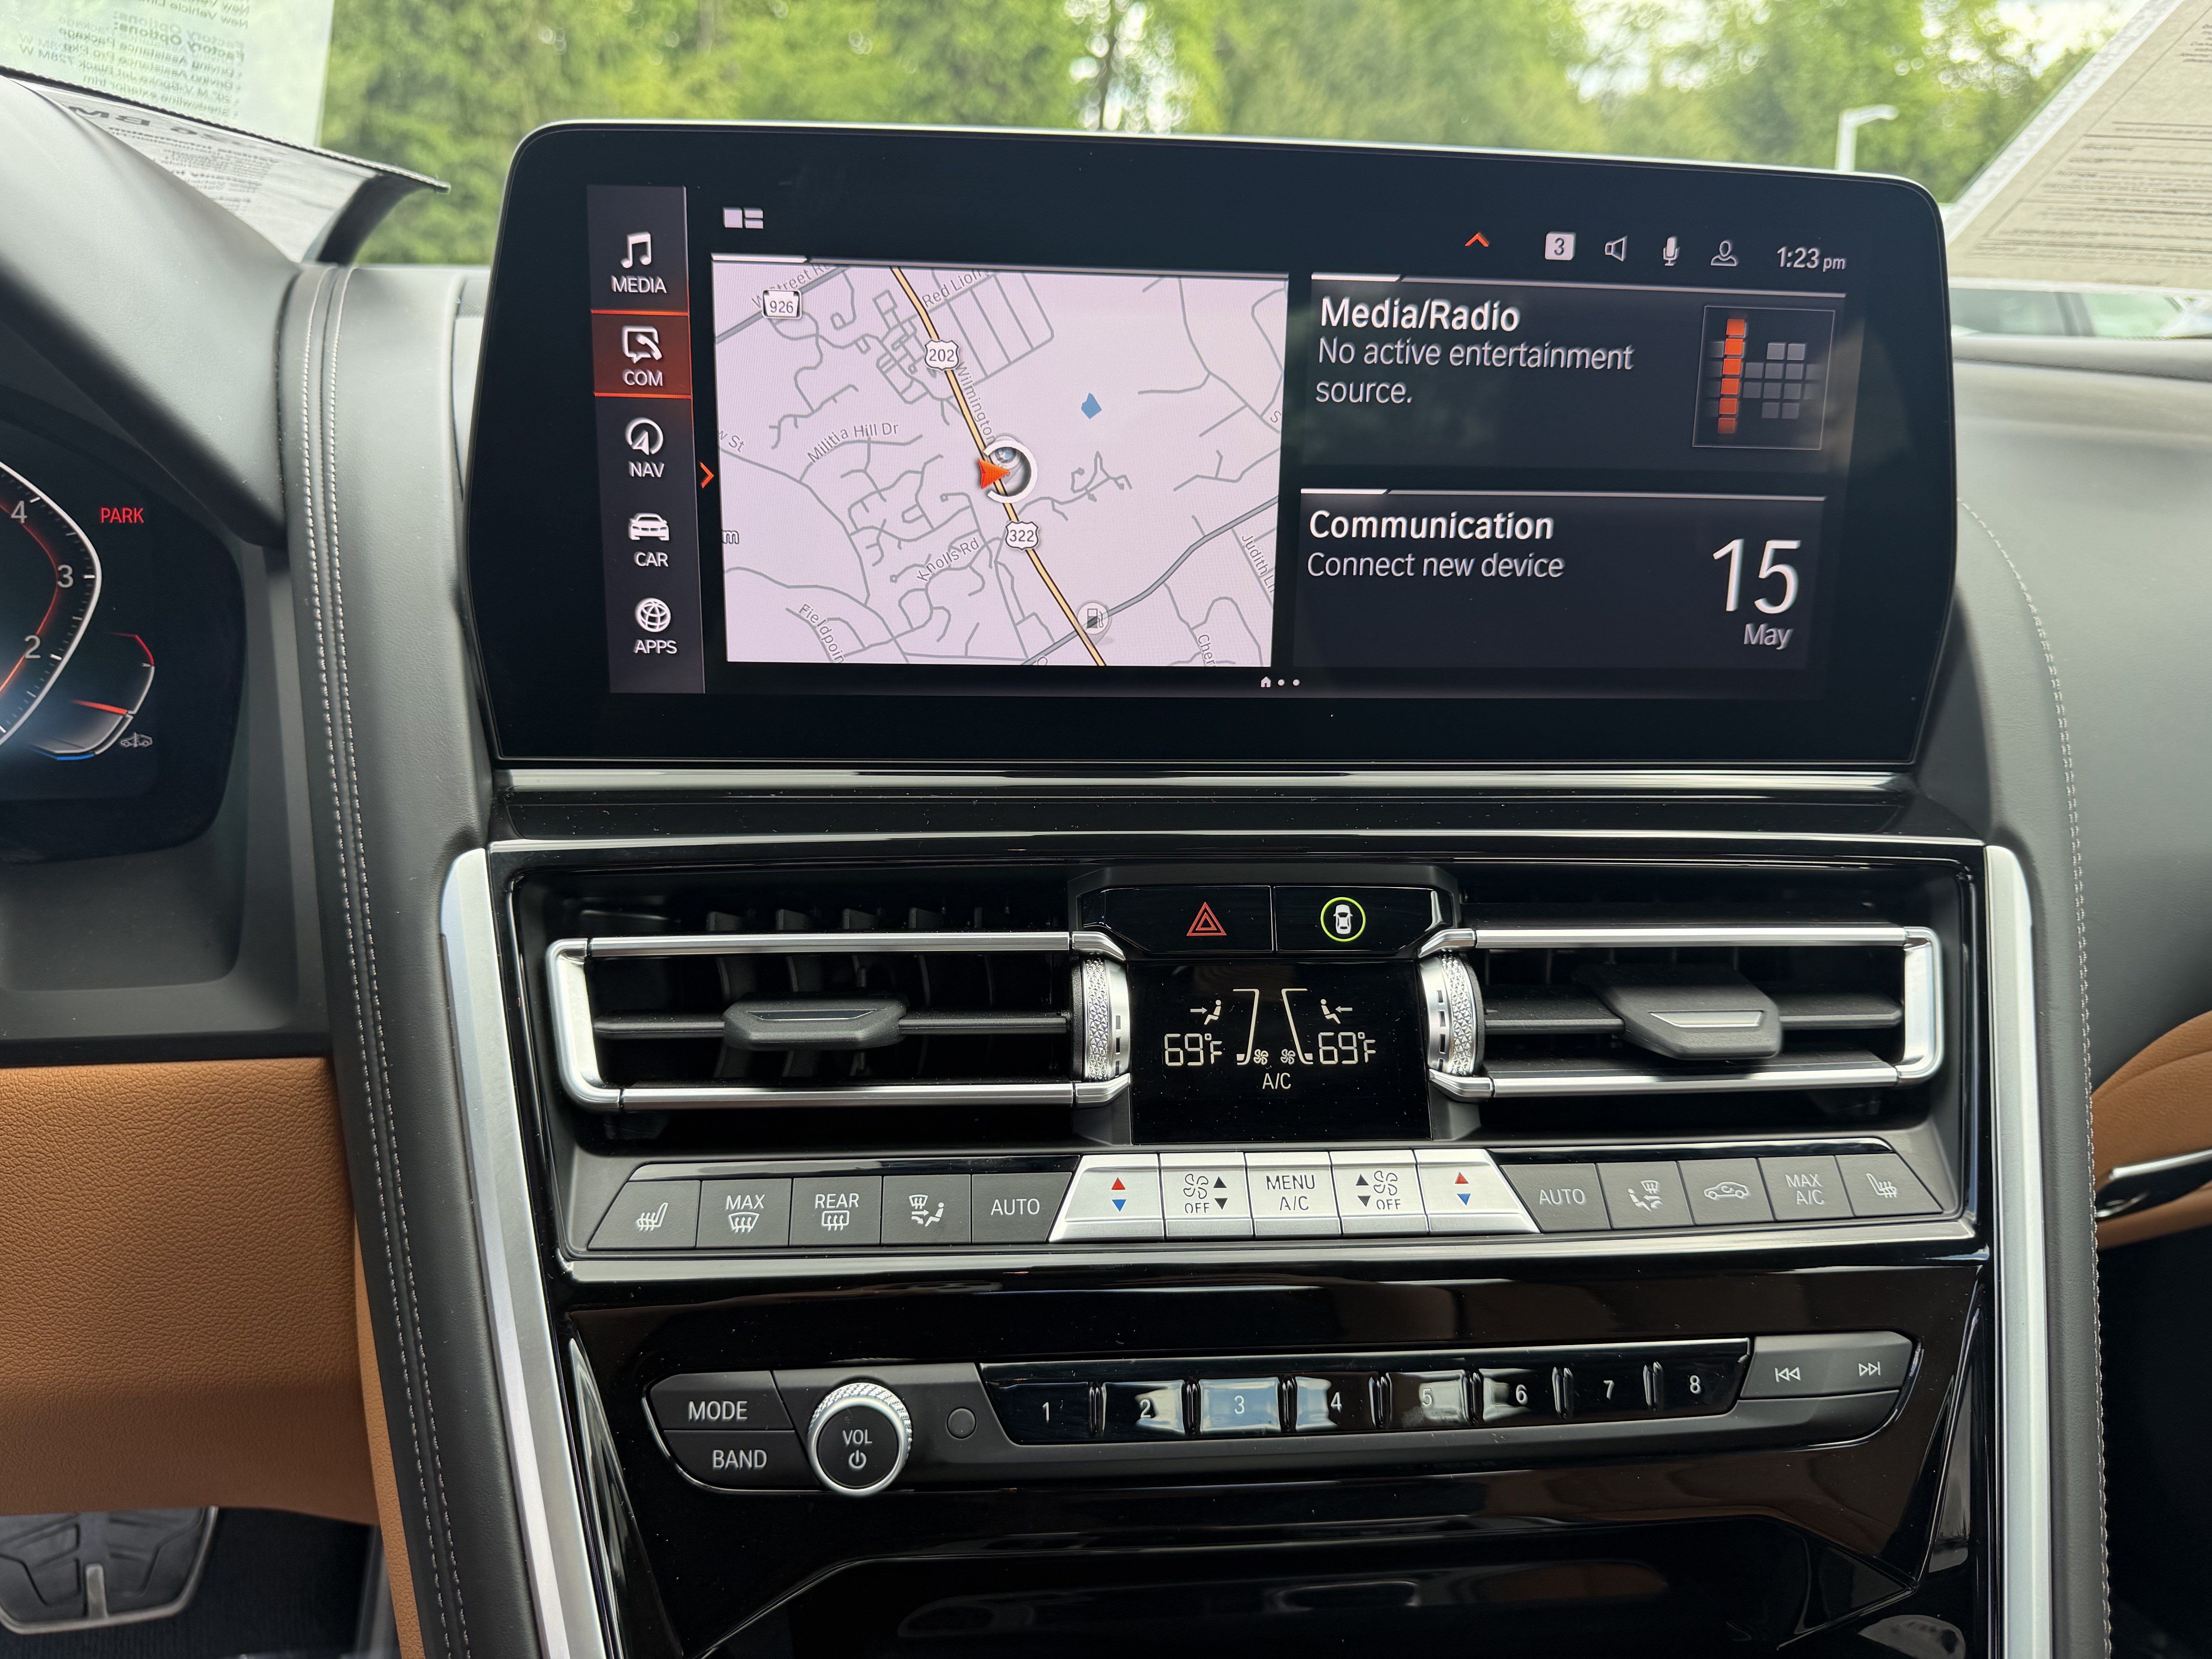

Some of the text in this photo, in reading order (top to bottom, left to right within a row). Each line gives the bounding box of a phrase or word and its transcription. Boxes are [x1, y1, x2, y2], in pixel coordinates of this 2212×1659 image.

[1554, 237, 1565, 256] 3
[1777, 246, 1846, 273] 1:23 pm
[611, 275, 667, 294] MEDIA
[922, 284, 950, 307] Red
[769, 300, 794, 314] 926
[1321, 296, 1521, 331] Media/Radio
[929, 348, 955, 362] 202
[1319, 335, 1635, 370] No active entertainment
[622, 369, 663, 386] COM
[1316, 380, 1413, 404] source.
[955, 361, 996, 447] Wilmington
[728, 435, 745, 452] St
[807, 422, 898, 463] Militia Hill Dr
[628, 461, 665, 477] NAV
[11, 501, 27, 523] 4
[100, 507, 144, 524] PARK
[1310, 510, 1554, 540] Communication
[1010, 529, 1034, 542] 322
[634, 551, 669, 567] CAR
[917, 538, 979, 581] Knolls Rd
[1242, 536, 1268, 575] Judith
[1307, 552, 1566, 577] Connect new device
[57, 565, 74, 588] 3
[1713, 538, 1801, 614] 15
[799, 603, 844, 663] Fieldpoin
[1743, 622, 1794, 650] May
[24, 635, 41, 659] 2
[634, 639, 678, 654] APPS
[1262, 1072, 1291, 1090] A/C
[1266, 1174, 1315, 1191] MENU
[1785, 1173, 1823, 1188] MAX
[725, 1194, 765, 1210] MAX
[814, 1192, 860, 1209] REAR
[1279, 1195, 1309, 1211] A/C
[1376, 1199, 1401, 1211] OFF
[1539, 1188, 1586, 1206] AUTO
[1796, 1190, 1825, 1206] A/C
[991, 1198, 1041, 1216] AUTO
[1185, 1202, 1210, 1214] OFF
[1515, 1384, 1528, 1403] 6
[1604, 1380, 1614, 1399] 7
[1689, 1375, 1701, 1394] 8
[1234, 1395, 1245, 1414] 3
[1330, 1392, 1343, 1411] 4
[1422, 1388, 1433, 1407] 5
[687, 1400, 748, 1422] MODE
[1042, 1401, 1050, 1423] 1
[1139, 1399, 1151, 1419] 2
[842, 1429, 872, 1446] VOL
[711, 1449, 767, 1470] BAND
